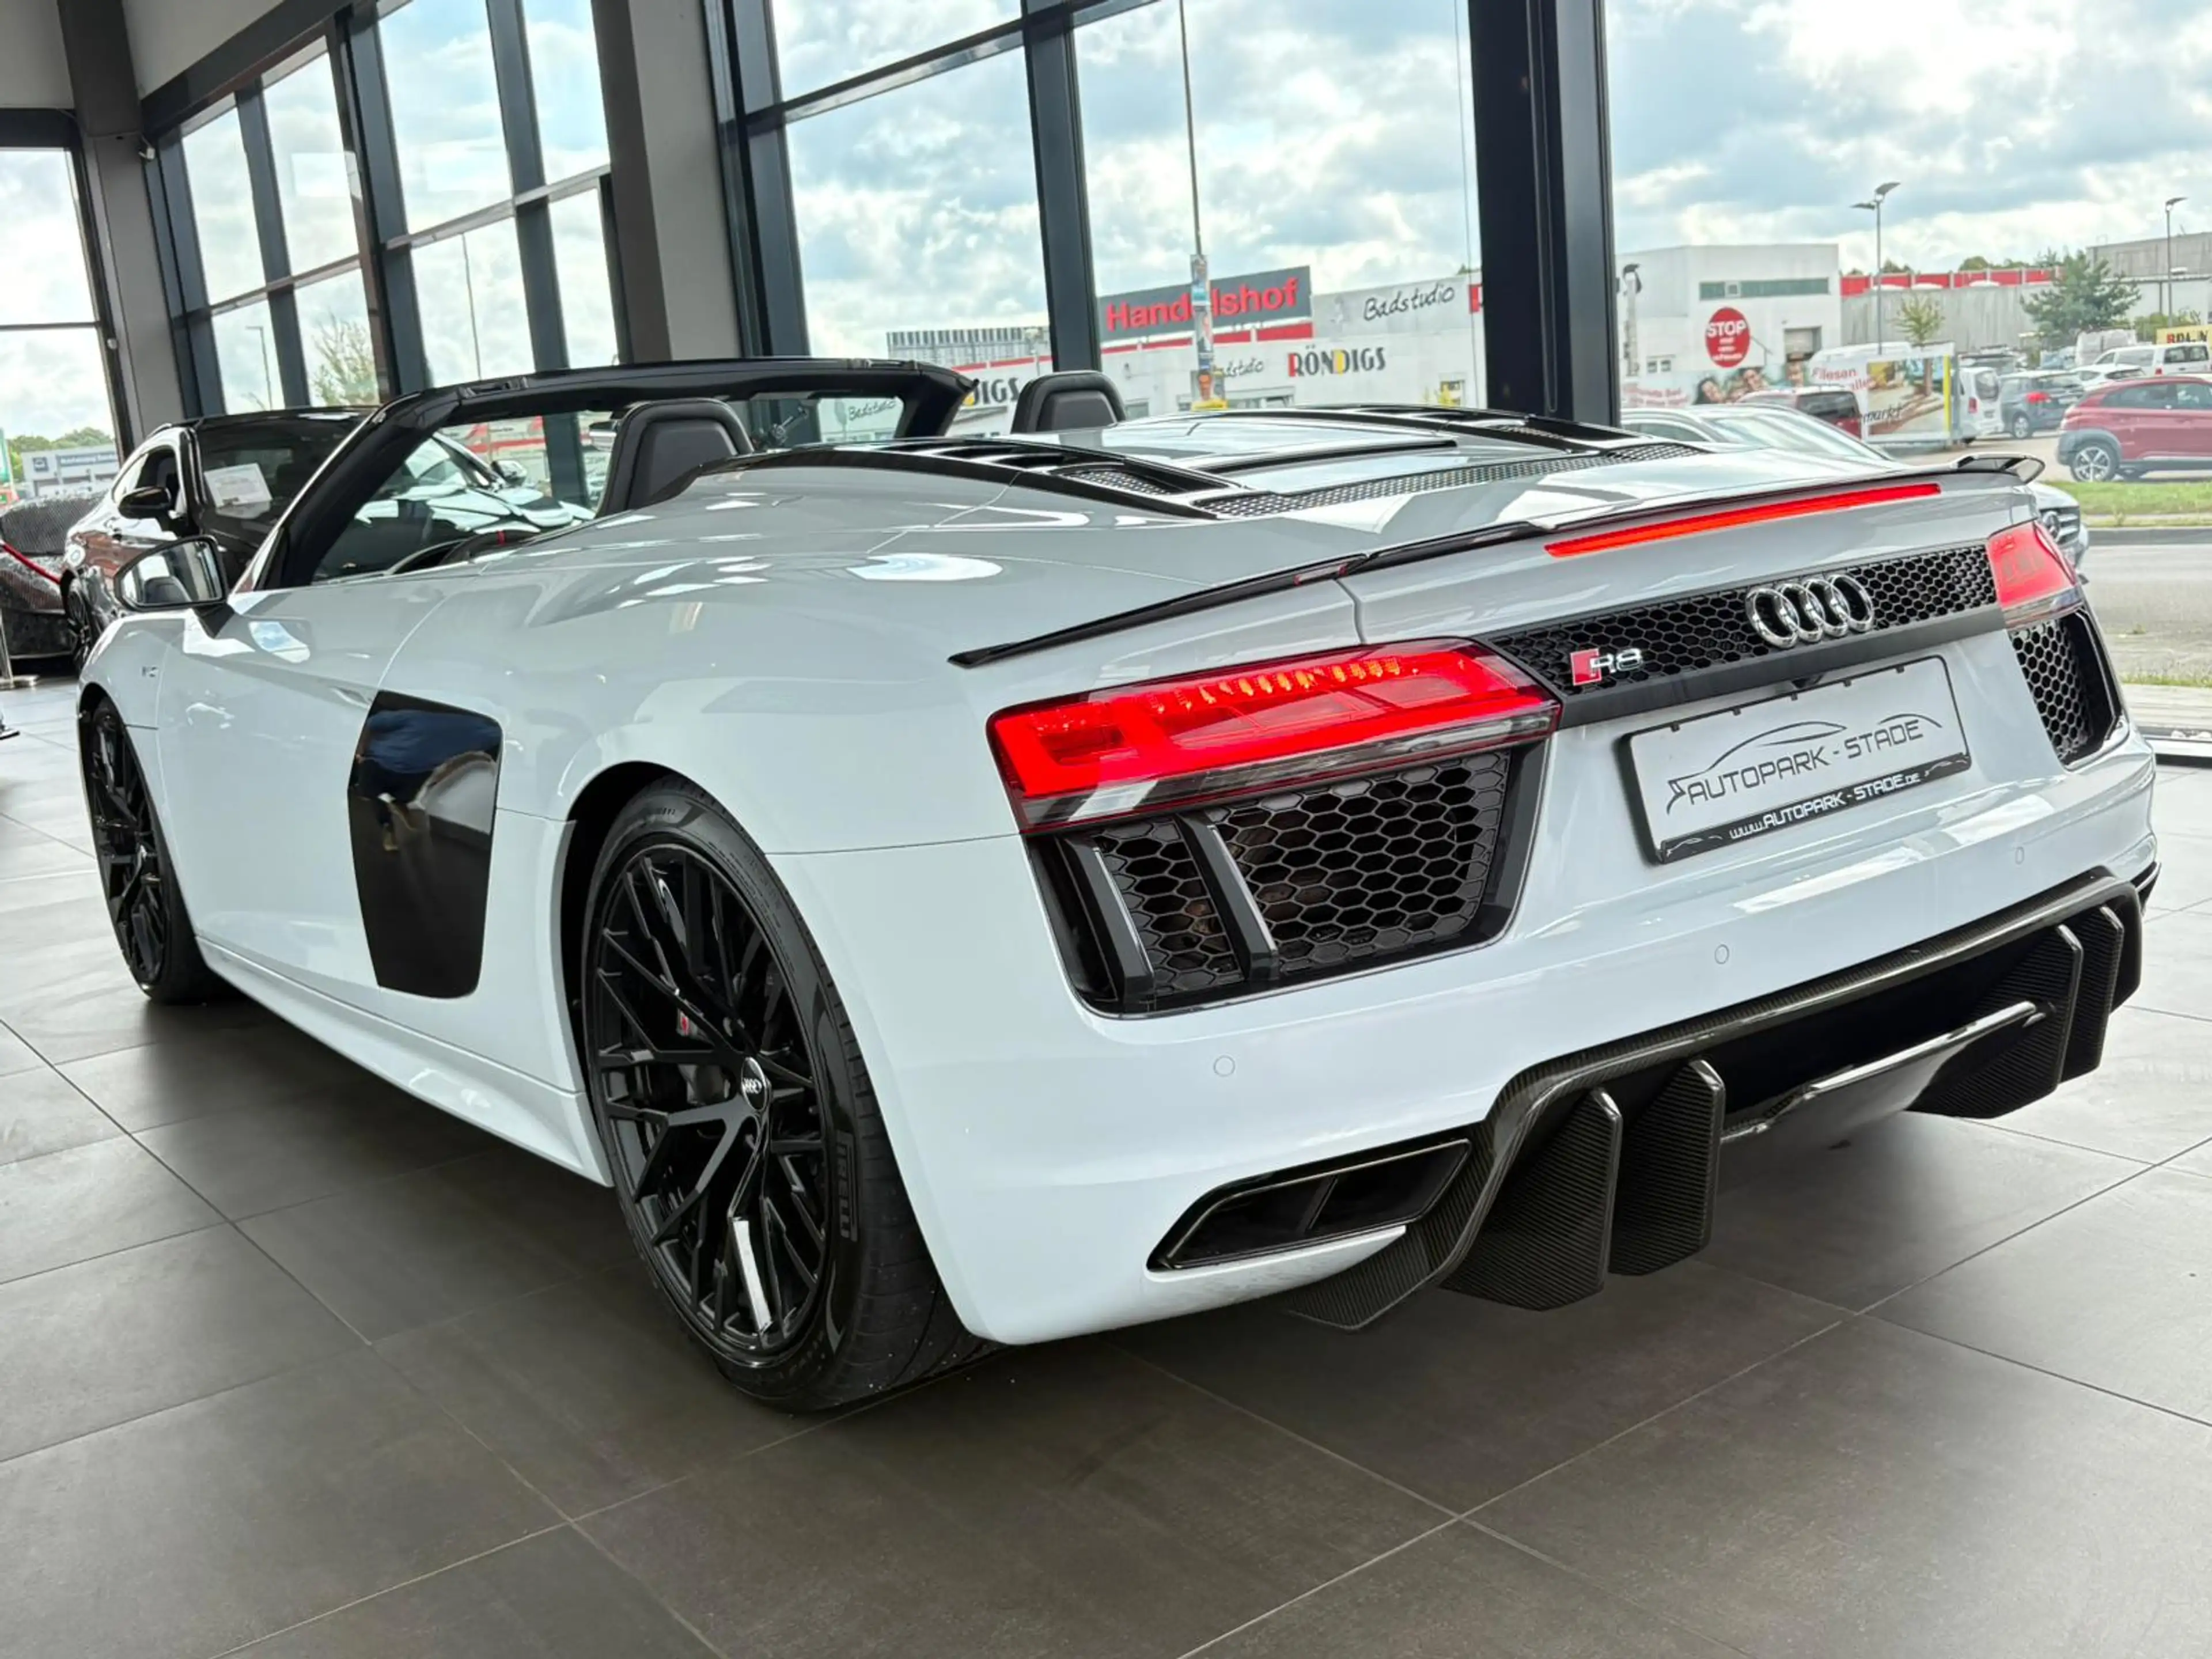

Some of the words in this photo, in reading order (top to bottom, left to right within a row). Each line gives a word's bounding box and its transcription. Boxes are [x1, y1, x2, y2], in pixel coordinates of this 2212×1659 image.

[1105, 277, 1300, 332] Handlshof
[1363, 283, 1455, 321] Badstudio
[1706, 320, 1747, 339] STOP
[1288, 344, 1387, 377] RÖNDIGS
[1590, 647, 1643, 678] R8
[1688, 745, 1831, 805] AUTOPARK
[1844, 719, 1924, 759] STADE
[1729, 791, 1847, 839] www.AUTOPARK
